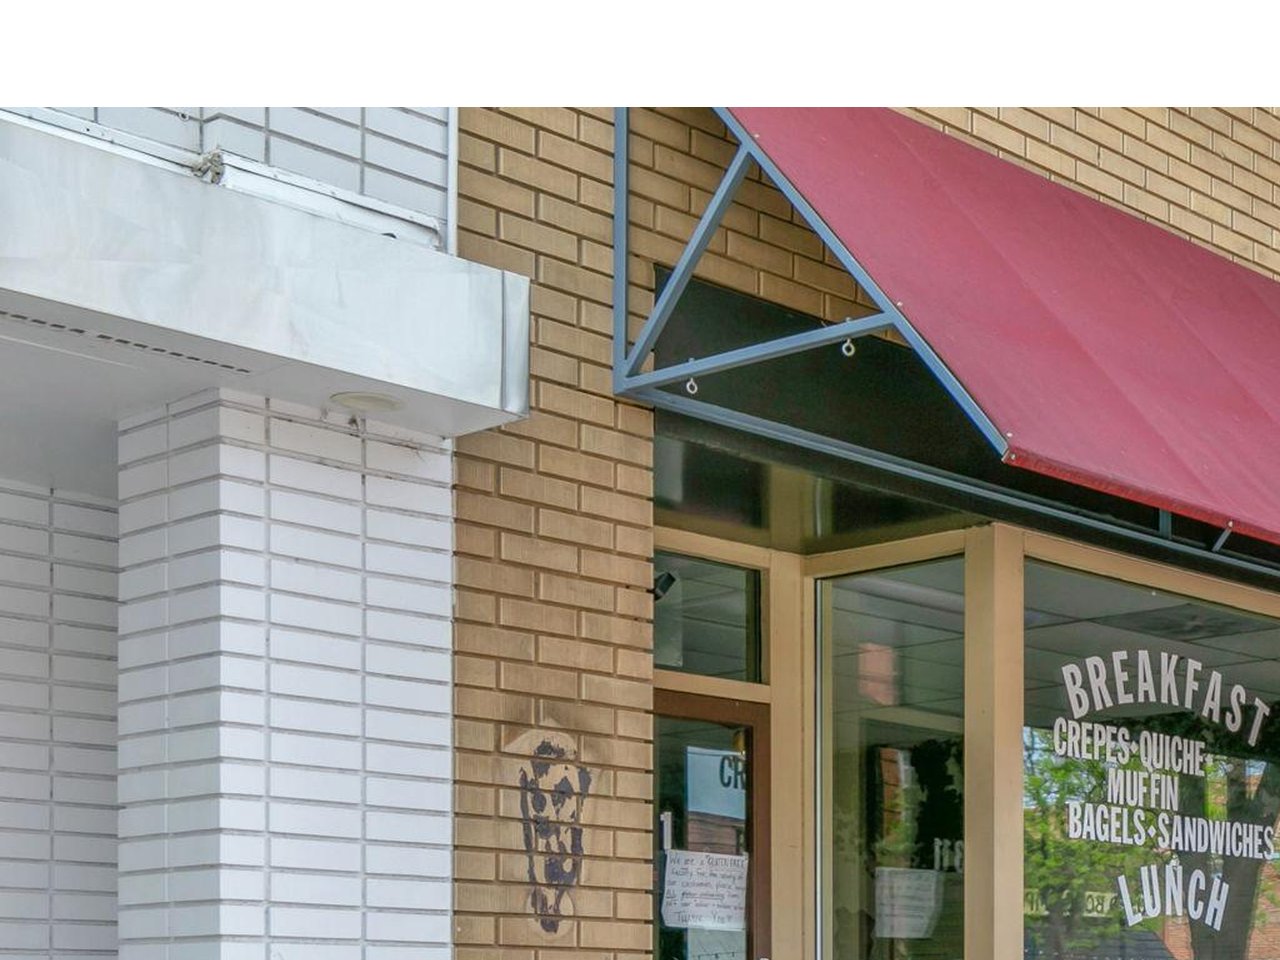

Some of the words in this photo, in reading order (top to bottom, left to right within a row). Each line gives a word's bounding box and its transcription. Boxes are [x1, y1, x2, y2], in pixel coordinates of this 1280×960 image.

[1062, 649, 1270, 748] BREAKFAST
[1107, 768, 1179, 811] MUFFIN
[1117, 864, 1230, 932] LUNCH
